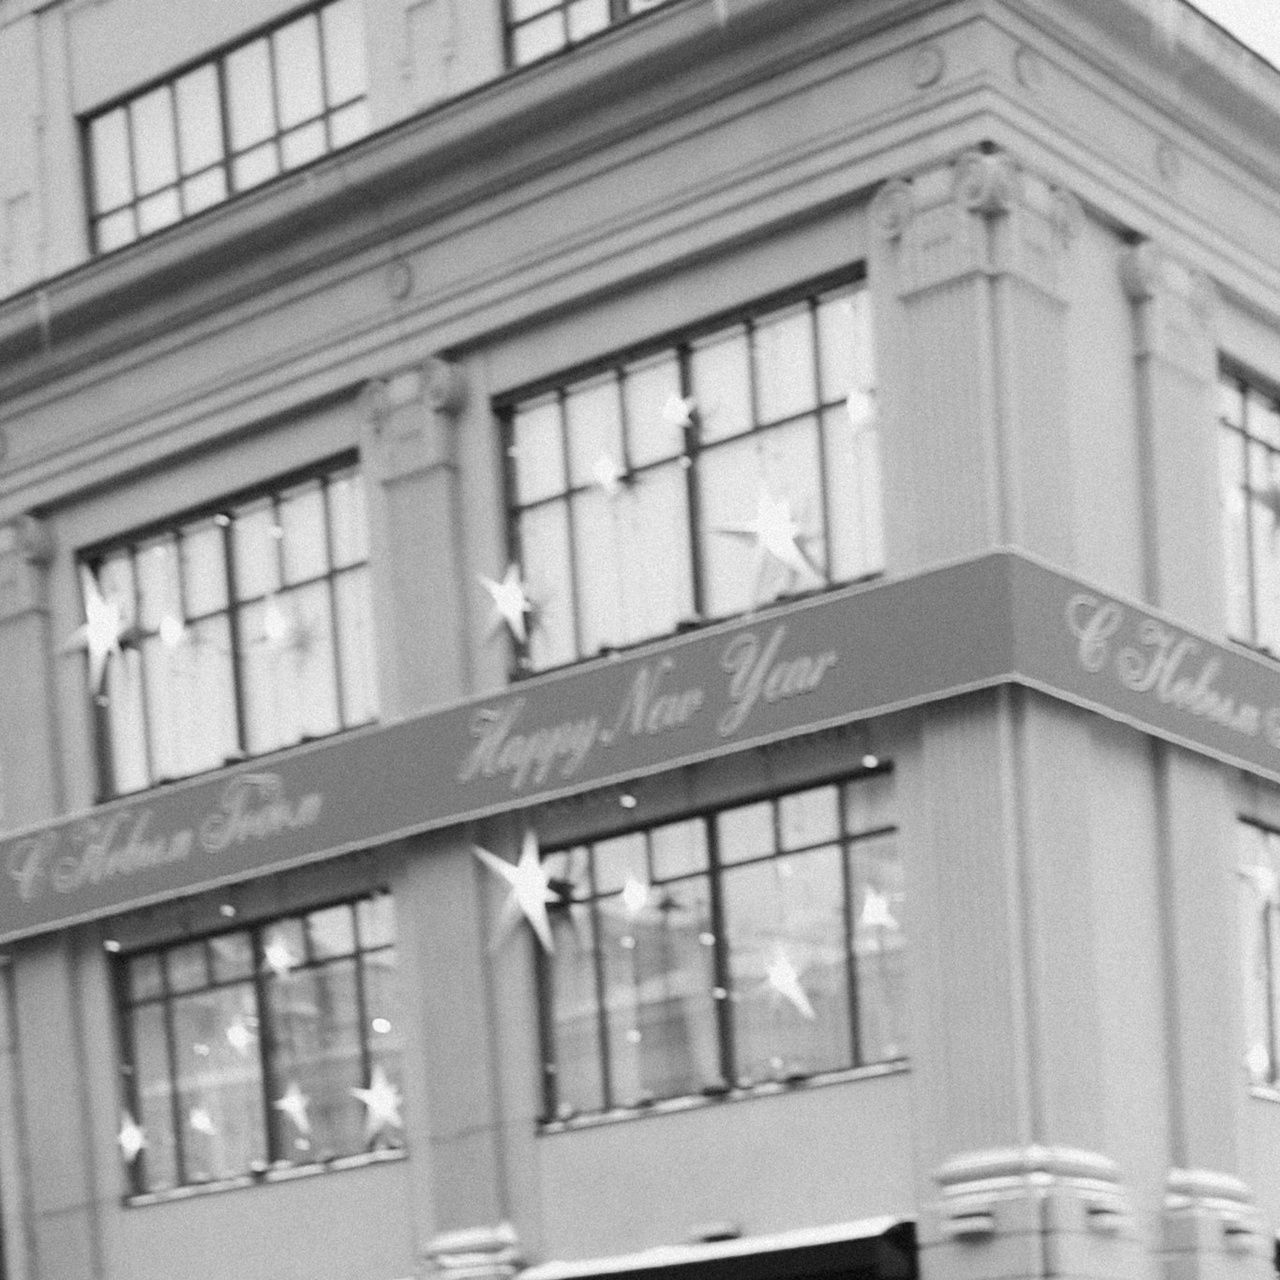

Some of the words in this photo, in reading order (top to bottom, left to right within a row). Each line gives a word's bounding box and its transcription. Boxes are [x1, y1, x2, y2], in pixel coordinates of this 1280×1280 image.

[456, 696, 598, 790] Happy
[599, 656, 705, 745] New
[717, 624, 838, 737] Year
